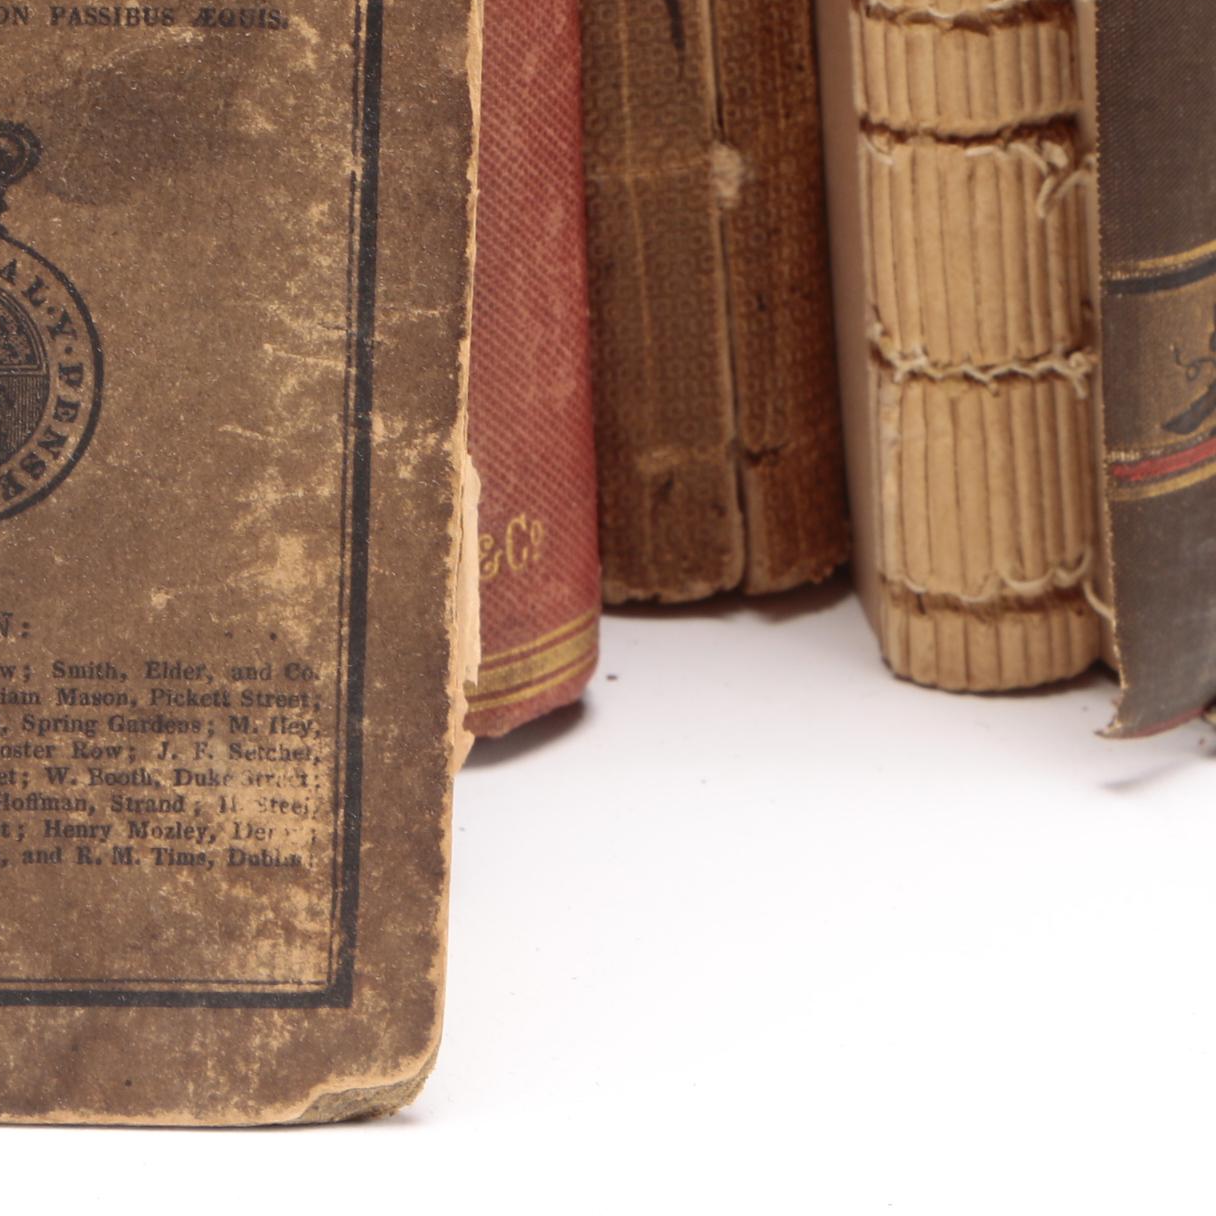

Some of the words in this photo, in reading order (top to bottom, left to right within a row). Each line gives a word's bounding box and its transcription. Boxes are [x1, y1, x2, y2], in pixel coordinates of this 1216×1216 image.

[50, 4, 175, 27] PASSIBUS
[51, 660, 128, 683] Smith,
[144, 660, 214, 685] Elder,
[230, 661, 273, 682] and
[283, 661, 322, 682] Co.
[55, 687, 138, 709] Mason,
[148, 687, 232, 709] Pickett
[239, 687, 323, 712] Street;
[20, 713, 99, 738] Spring
[106, 713, 216, 739] Gardens;
[228, 714, 259, 735] M.
[71, 740, 136, 765] Row;
[156, 740, 179, 762] J.
[192, 741, 215, 762] F.
[43, 765, 79, 786] W.
[43, 819, 113, 844] Henry
[127, 820, 217, 845] Mozley,
[21, 845, 64, 865] and
[75, 845, 103, 867] R.
[111, 845, 141, 867] M.
